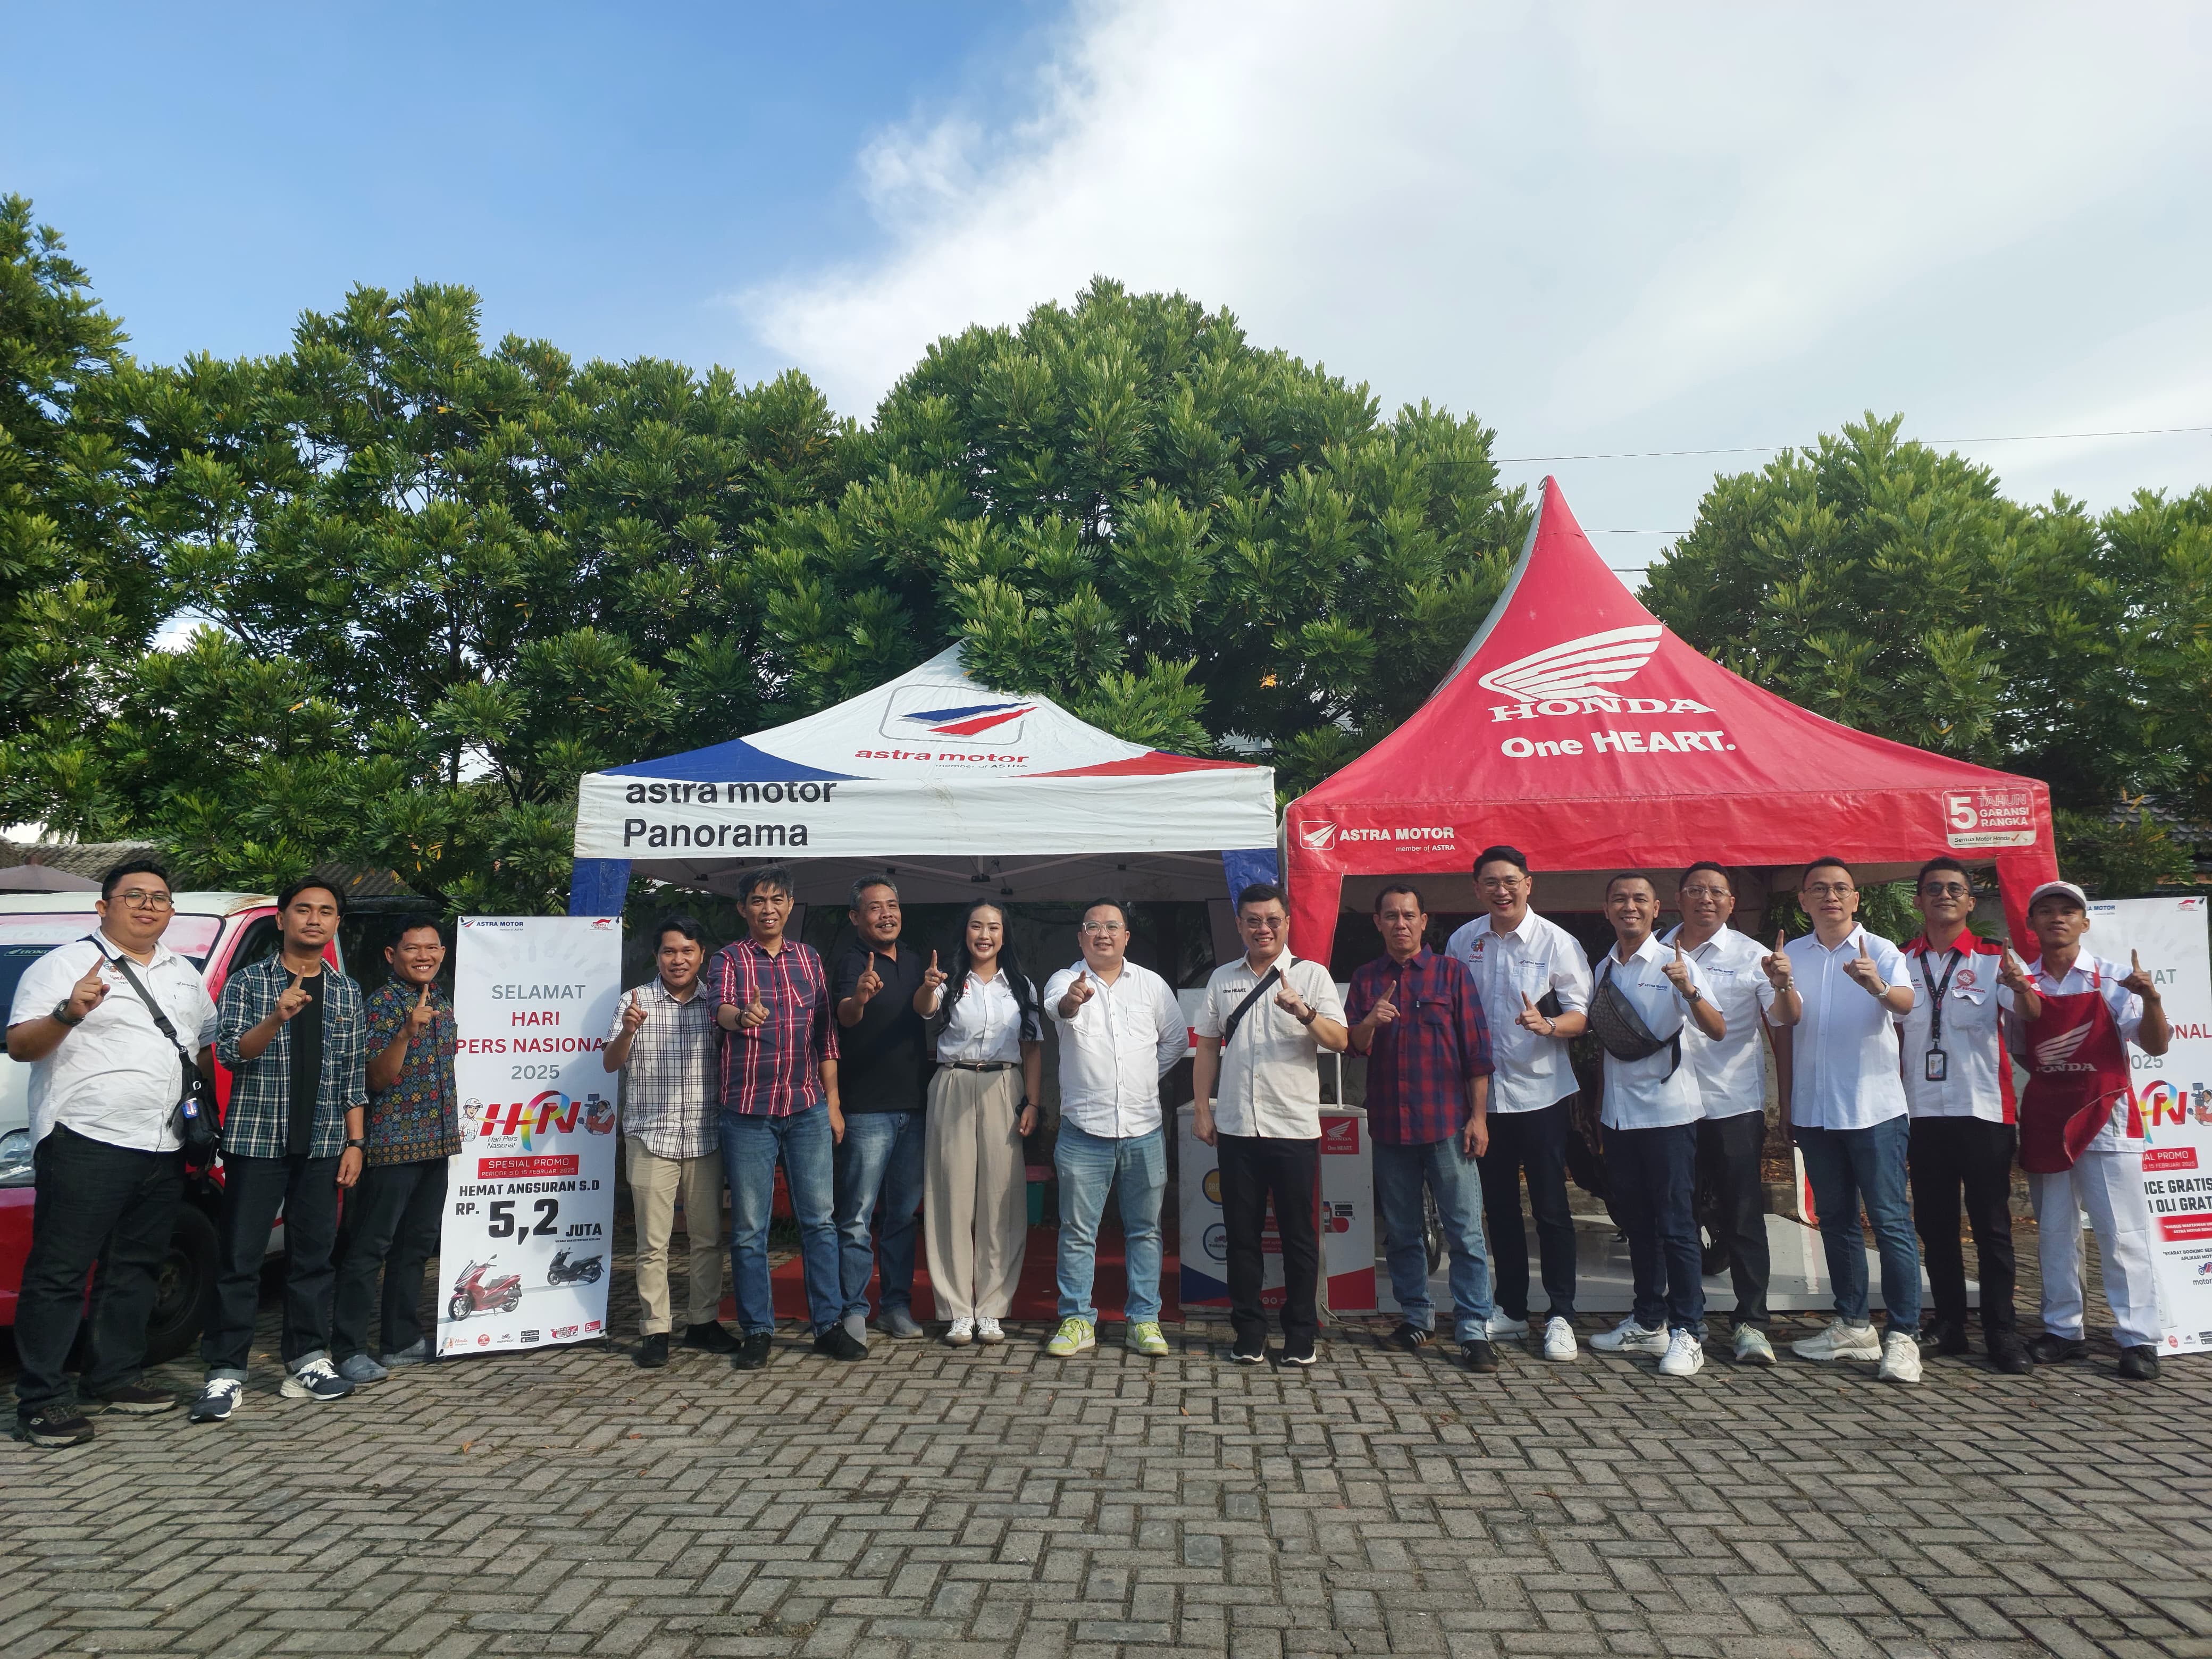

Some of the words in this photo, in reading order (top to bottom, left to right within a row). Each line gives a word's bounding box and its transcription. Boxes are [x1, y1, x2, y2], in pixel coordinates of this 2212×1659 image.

[1488, 697, 1716, 722] HONDA
[1501, 737, 1583, 758] One
[1591, 730, 1736, 753] HEART.
[854, 749, 931, 760] astra
[939, 753, 1029, 763] motor
[625, 782, 718, 804] astra
[727, 782, 837, 803] motor
[1978, 794, 2026, 807] TAHUN
[1950, 797, 1978, 830] 5
[1980, 807, 2029, 817] GARANSI
[1981, 817, 2028, 827] RANGKA
[624, 818, 809, 848] Panorama
[1339, 829, 1392, 841] ASTRA
[1395, 827, 1454, 840] MOTOR
[491, 984, 586, 1000] SELAMAT
[511, 1011, 559, 1026] HARI
[2175, 1024, 2212, 1039] NAL
[456, 1038, 506, 1054] PERS
[513, 1037, 603, 1053] NASIONA
[2131, 1054, 2163, 1069] 025
[510, 1064, 559, 1080] 2025
[2157, 1151, 2189, 1160] PROMO
[488, 1160, 530, 1169] SPESIAL
[534, 1158, 569, 1167] PROMO
[459, 1184, 504, 1197] HEMAT
[507, 1181, 575, 1194] ANGSURAN
[579, 1180, 600, 1191] S.D
[2144, 1180, 2165, 1195] ICE
[456, 1202, 480, 1216] RP.
[2156, 1199, 2176, 1212] OLI
[2179, 1196, 2212, 1211] GRAT
[488, 1199, 559, 1245] 5,2
[565, 1223, 602, 1237] JUTA
[2193, 1277, 2212, 1286] motor
